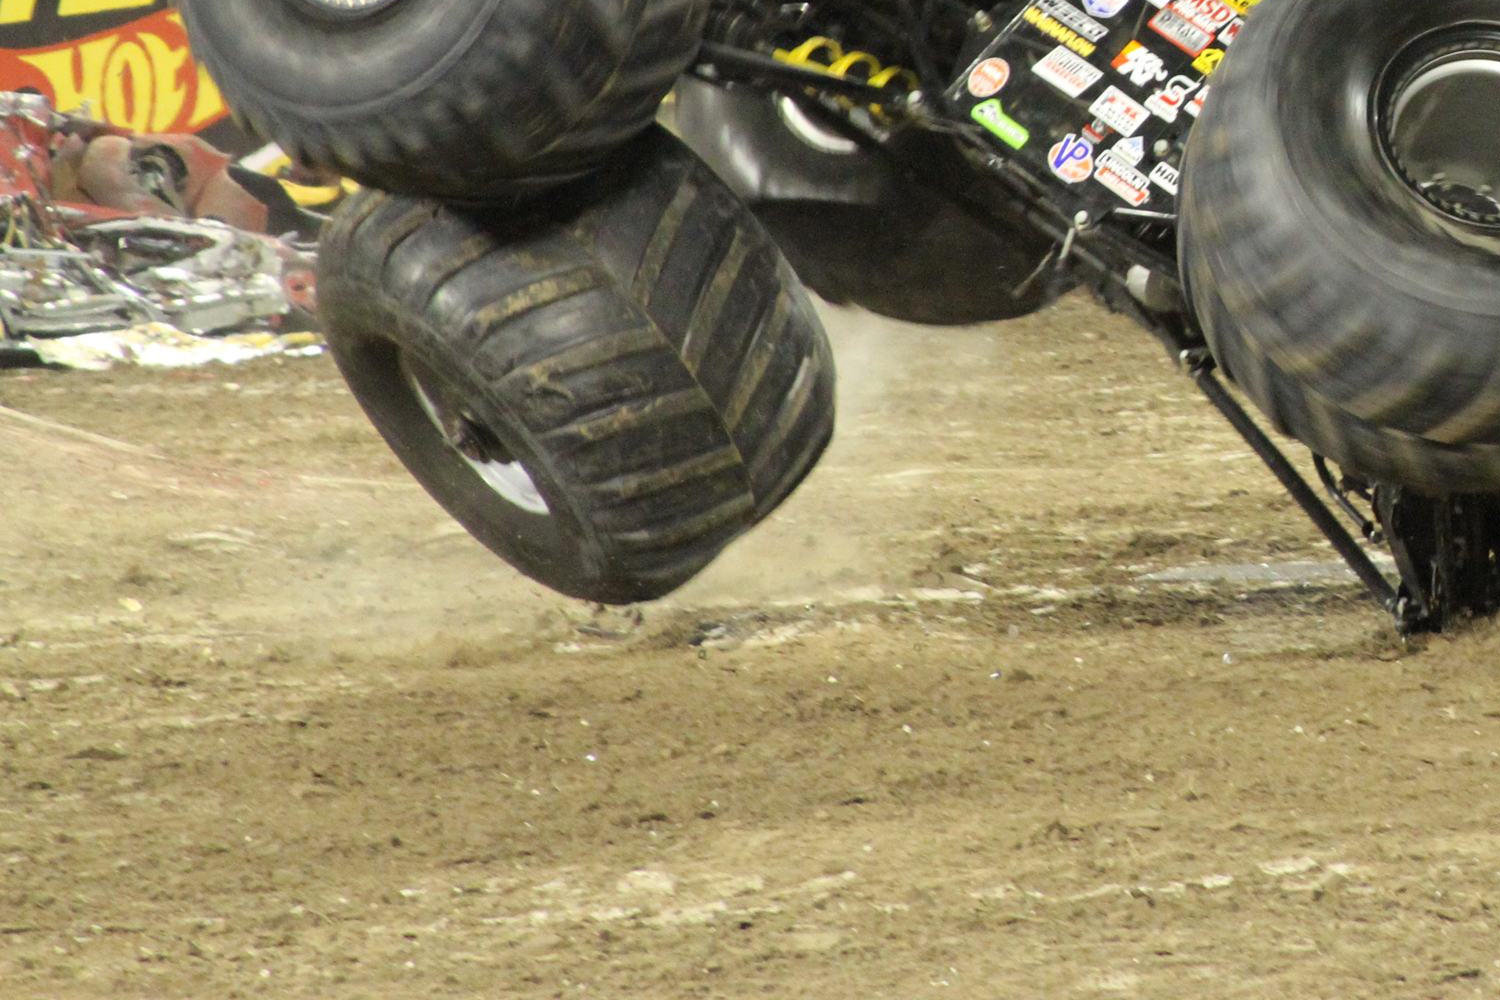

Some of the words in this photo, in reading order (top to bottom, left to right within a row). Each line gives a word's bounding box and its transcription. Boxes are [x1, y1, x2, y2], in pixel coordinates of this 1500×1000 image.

[17, 32, 189, 133] HOT
[1052, 136, 1090, 169] VP
[1098, 152, 1147, 191] LINCOLN
